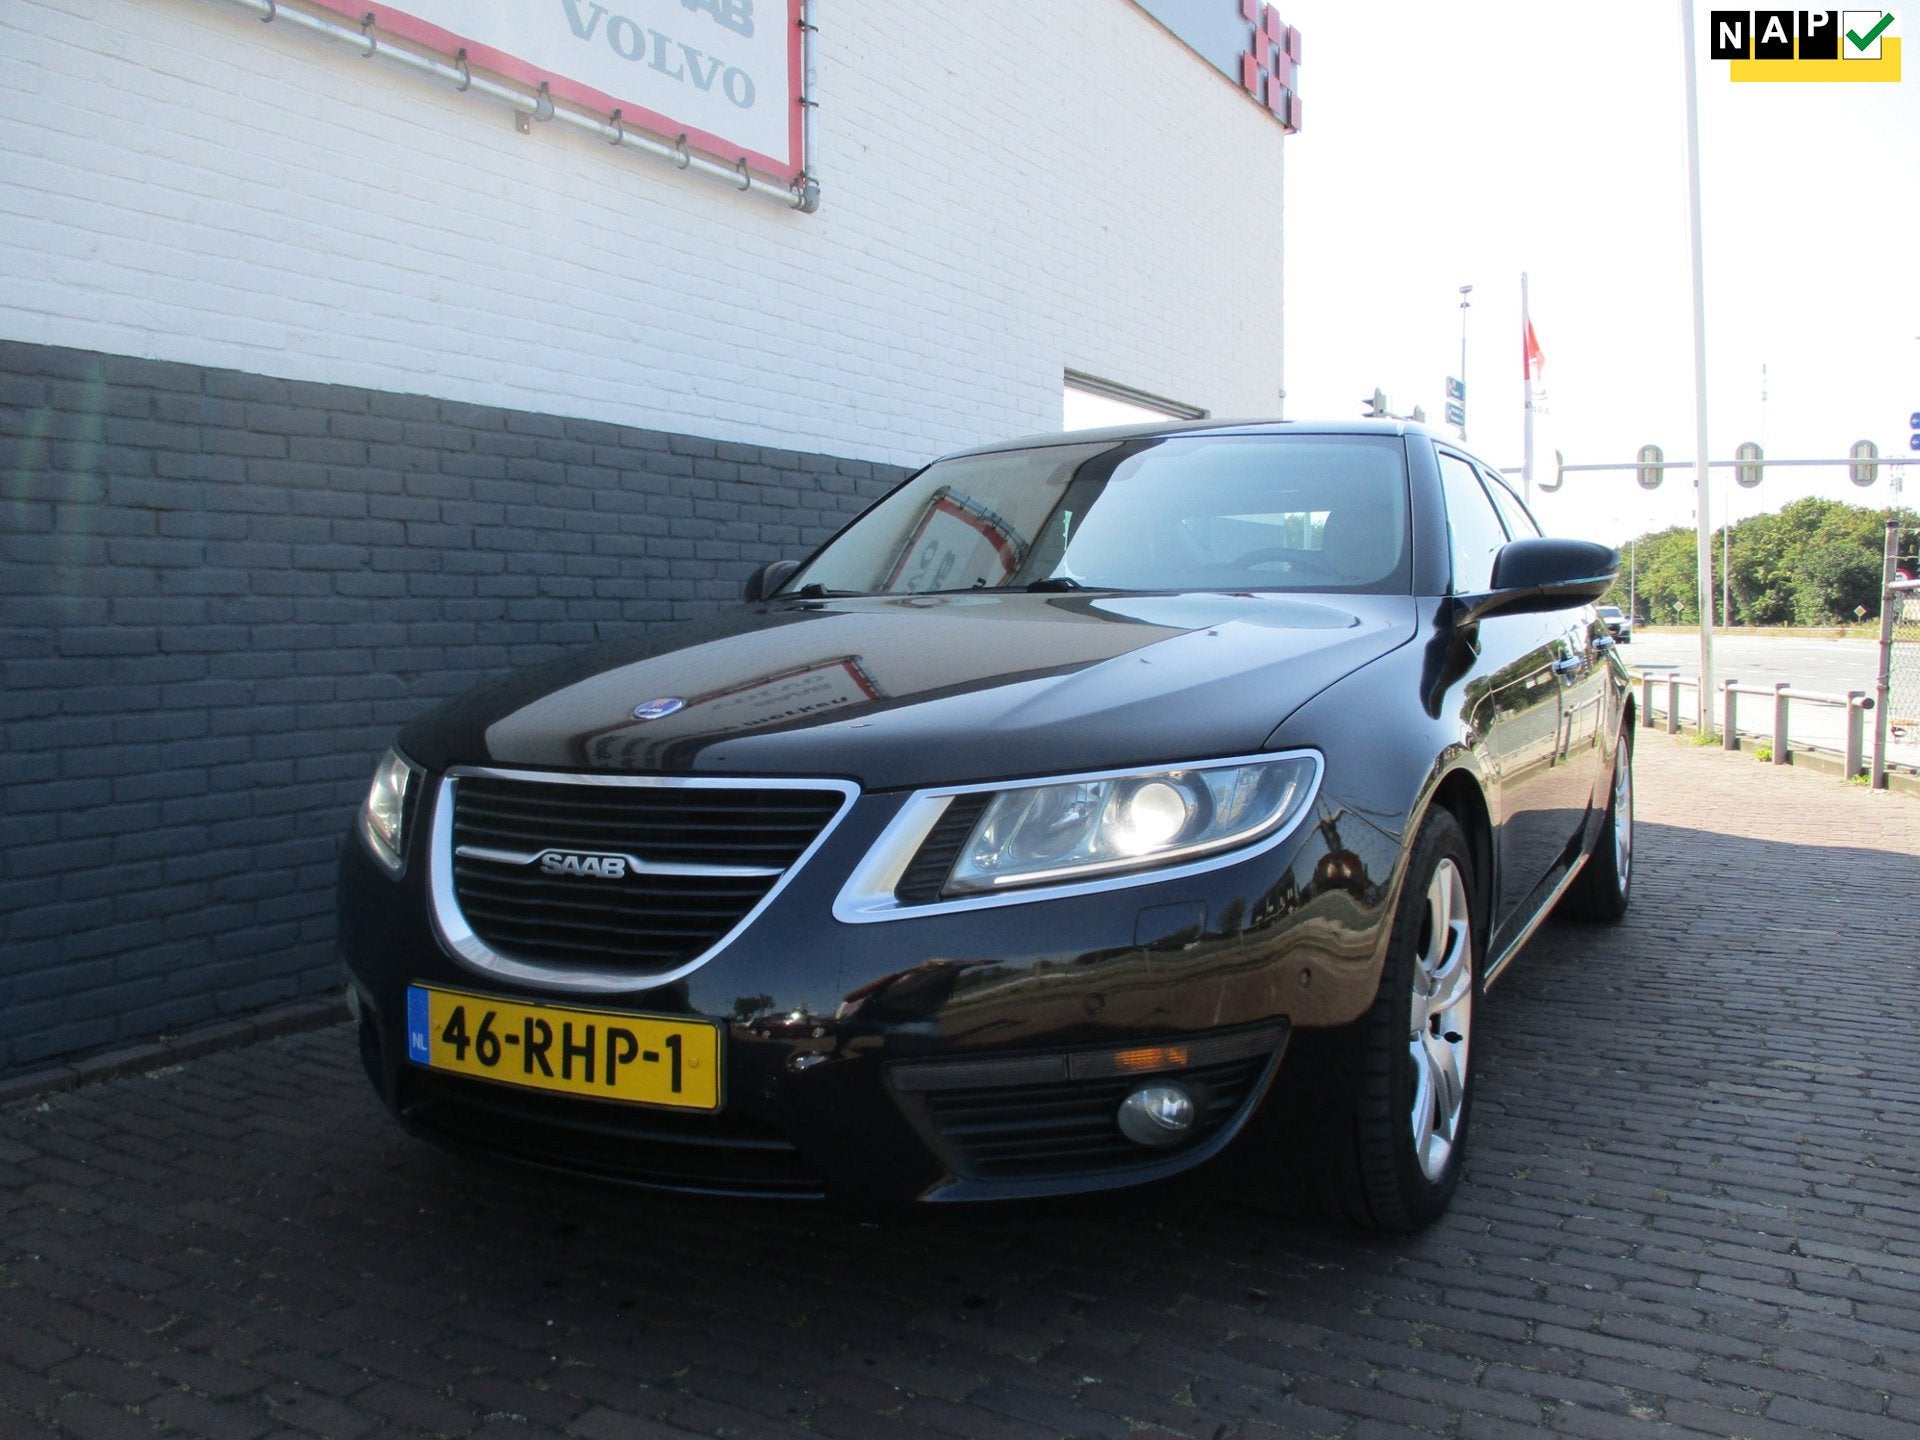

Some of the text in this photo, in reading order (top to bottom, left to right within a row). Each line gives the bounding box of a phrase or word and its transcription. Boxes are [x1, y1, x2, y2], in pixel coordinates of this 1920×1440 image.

[561, 0, 756, 109] VOLVO
[540, 853, 626, 879] SAAB
[412, 1030, 428, 1052] NL
[441, 1005, 683, 1094] 46-RHP-1
